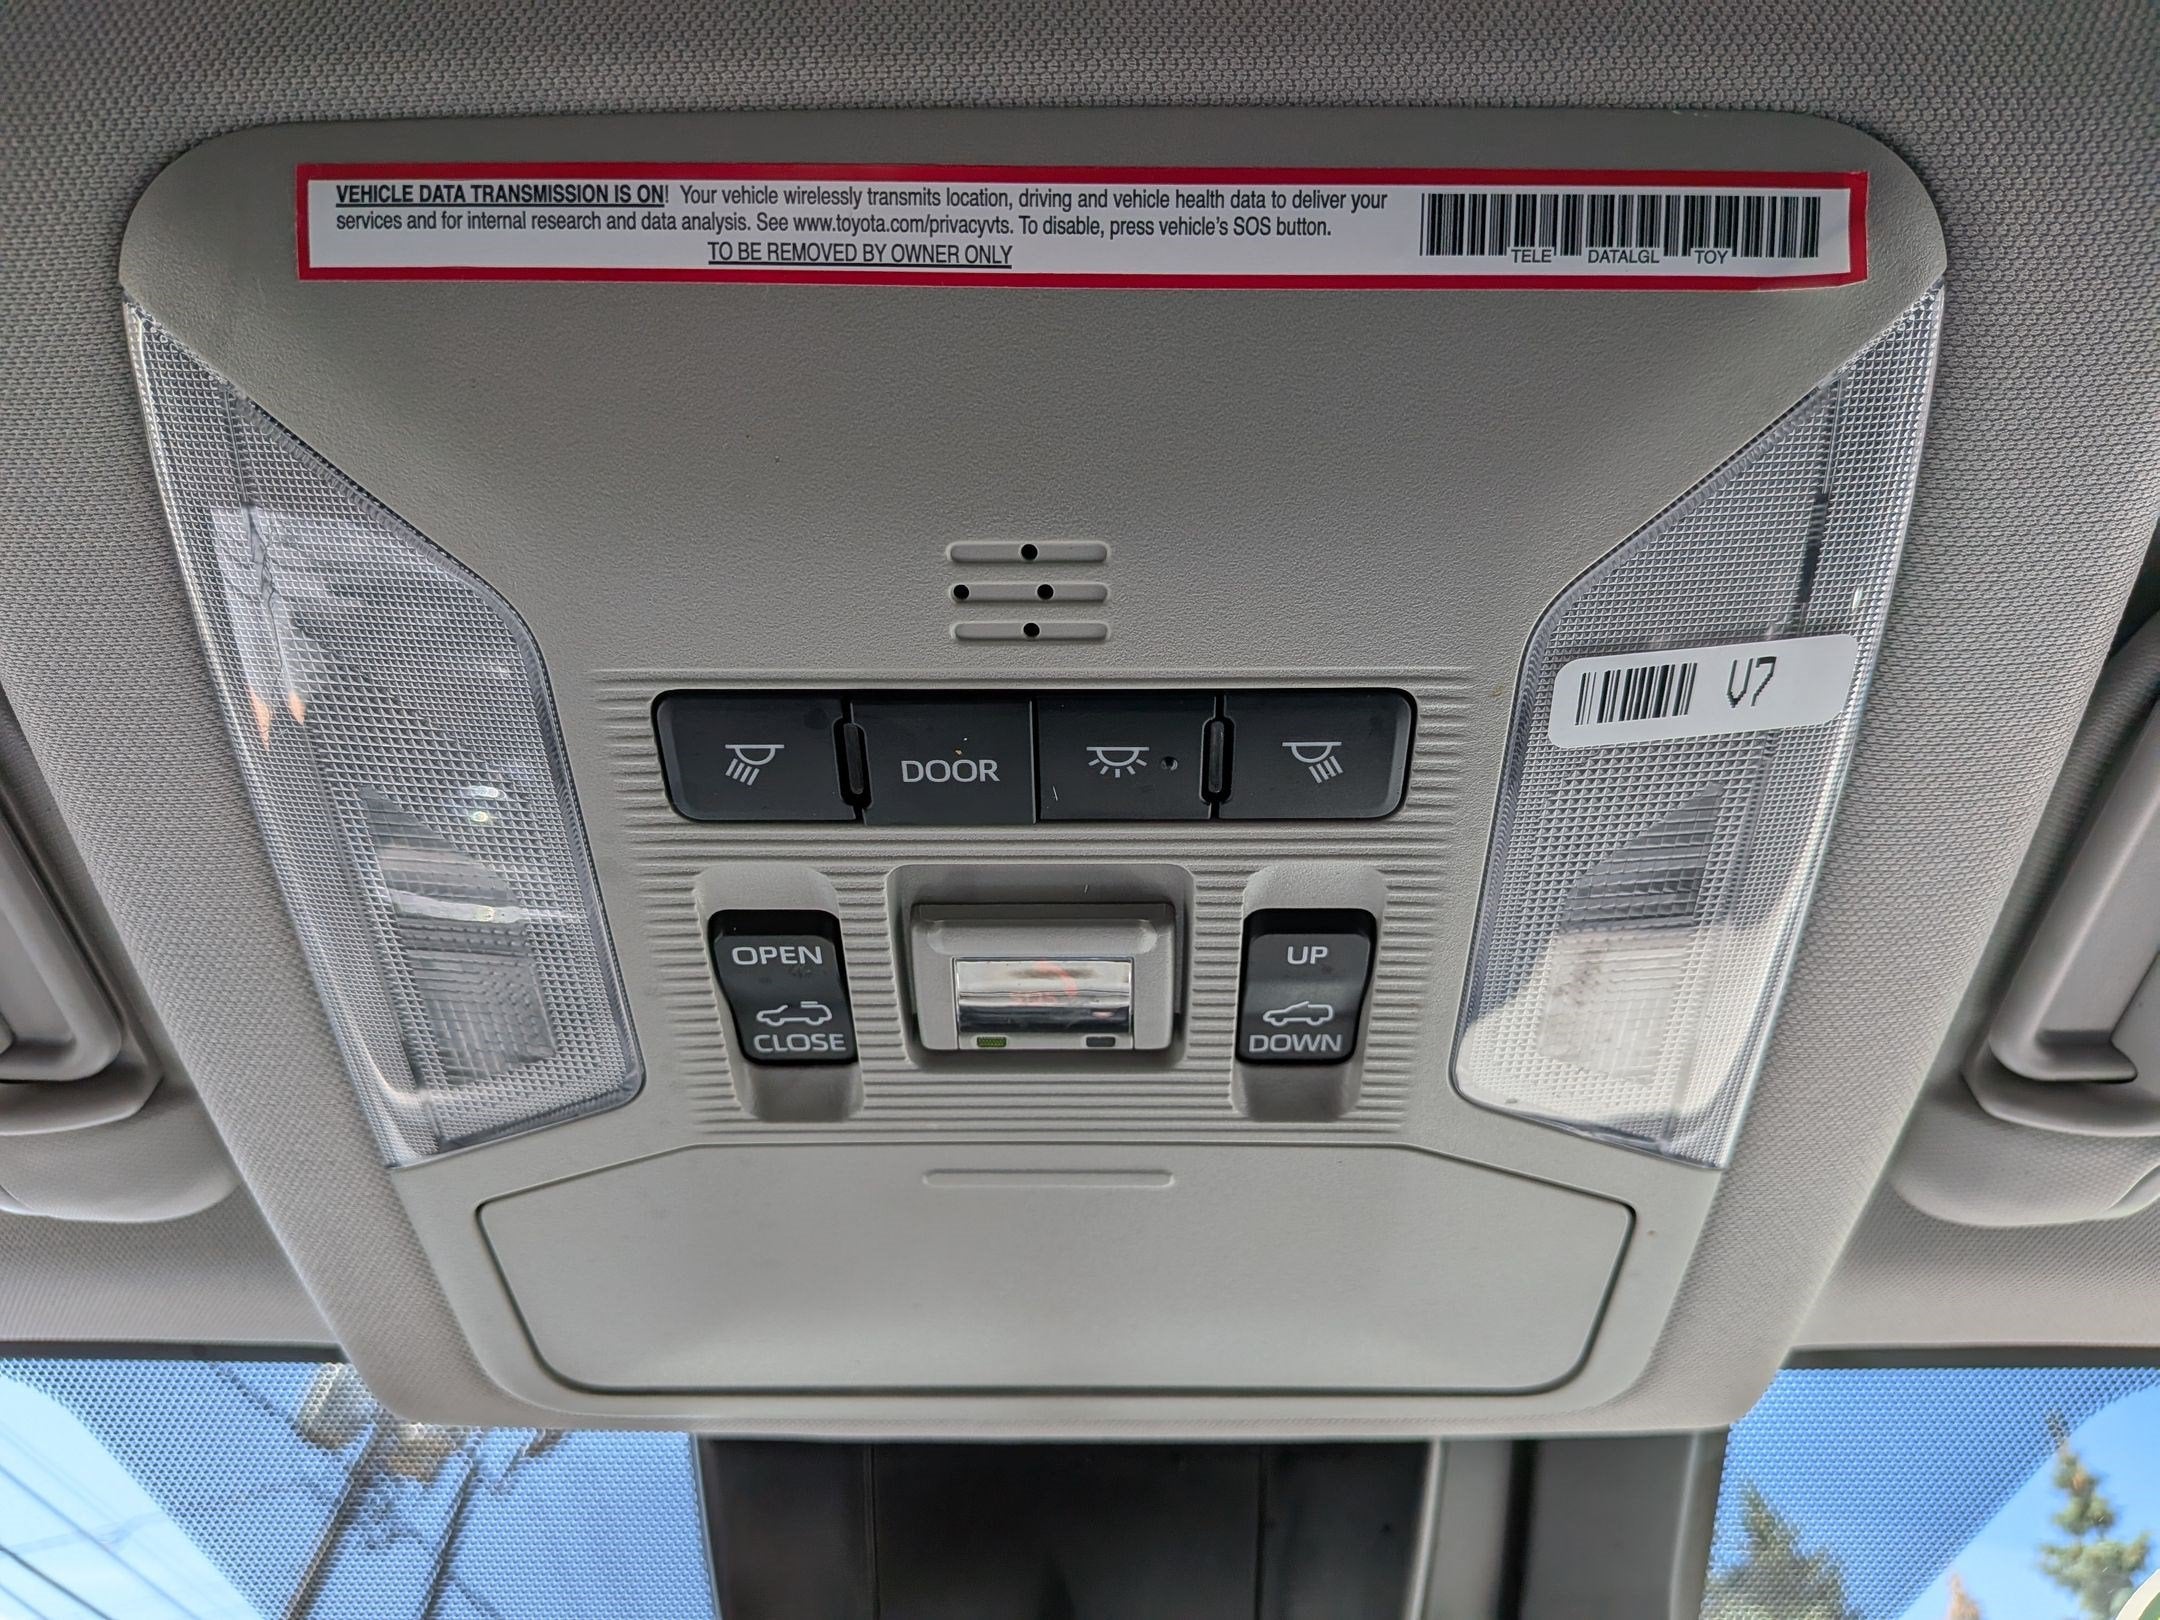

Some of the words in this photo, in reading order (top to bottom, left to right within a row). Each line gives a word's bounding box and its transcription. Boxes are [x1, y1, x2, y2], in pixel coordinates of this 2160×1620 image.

[335, 184, 414, 203] VEHICLE
[419, 185, 467, 203] DATA
[469, 185, 609, 203] TRANSMISSION
[614, 185, 632, 204] IS
[636, 186, 669, 204] ON!
[680, 186, 718, 204] Your
[721, 186, 779, 204] vehicle
[783, 187, 863, 209] wirelessly
[866, 187, 942, 205] transmits
[946, 187, 1013, 210] location,
[1018, 188, 1072, 210] driving
[1077, 188, 1108, 206] and
[1112, 188, 1170, 206] vehicle
[1175, 189, 1225, 207] health
[1230, 189, 1266, 207] data
[1270, 189, 1287, 207] to
[1291, 189, 1347, 207] deliver
[1350, 193, 1389, 212] your
[336, 211, 403, 229] services
[406, 211, 437, 230] and
[440, 212, 464, 230] for
[467, 212, 527, 230] internal
[531, 212, 602, 231] research
[606, 213, 637, 231] and
[640, 213, 678, 231] data
[681, 213, 751, 235] analysis.
[756, 213, 789, 232] See
[792, 214, 1014, 236] www.toyota.com/privacyvts.
[1019, 215, 1039, 233] To
[1042, 215, 1105, 237] disable,
[1110, 219, 1155, 238] press
[1232, 216, 1272, 234] SOS
[1276, 216, 1332, 235] button.
[707, 242, 733, 261] TO
[737, 242, 762, 261] BE
[767, 243, 858, 262] REMOVED
[862, 243, 887, 262] BY
[890, 243, 960, 262] OWNER
[964, 244, 1013, 263] ONLY
[1511, 249, 1553, 263] TELE
[1587, 250, 1660, 264] DATALGL
[1694, 250, 1729, 264] TOY
[901, 759, 999, 784] DOOR
[732, 945, 822, 966] OPEN
[1286, 946, 1328, 965] UP
[753, 1032, 845, 1054] CLOSE
[1249, 1033, 1342, 1054] DOWN
